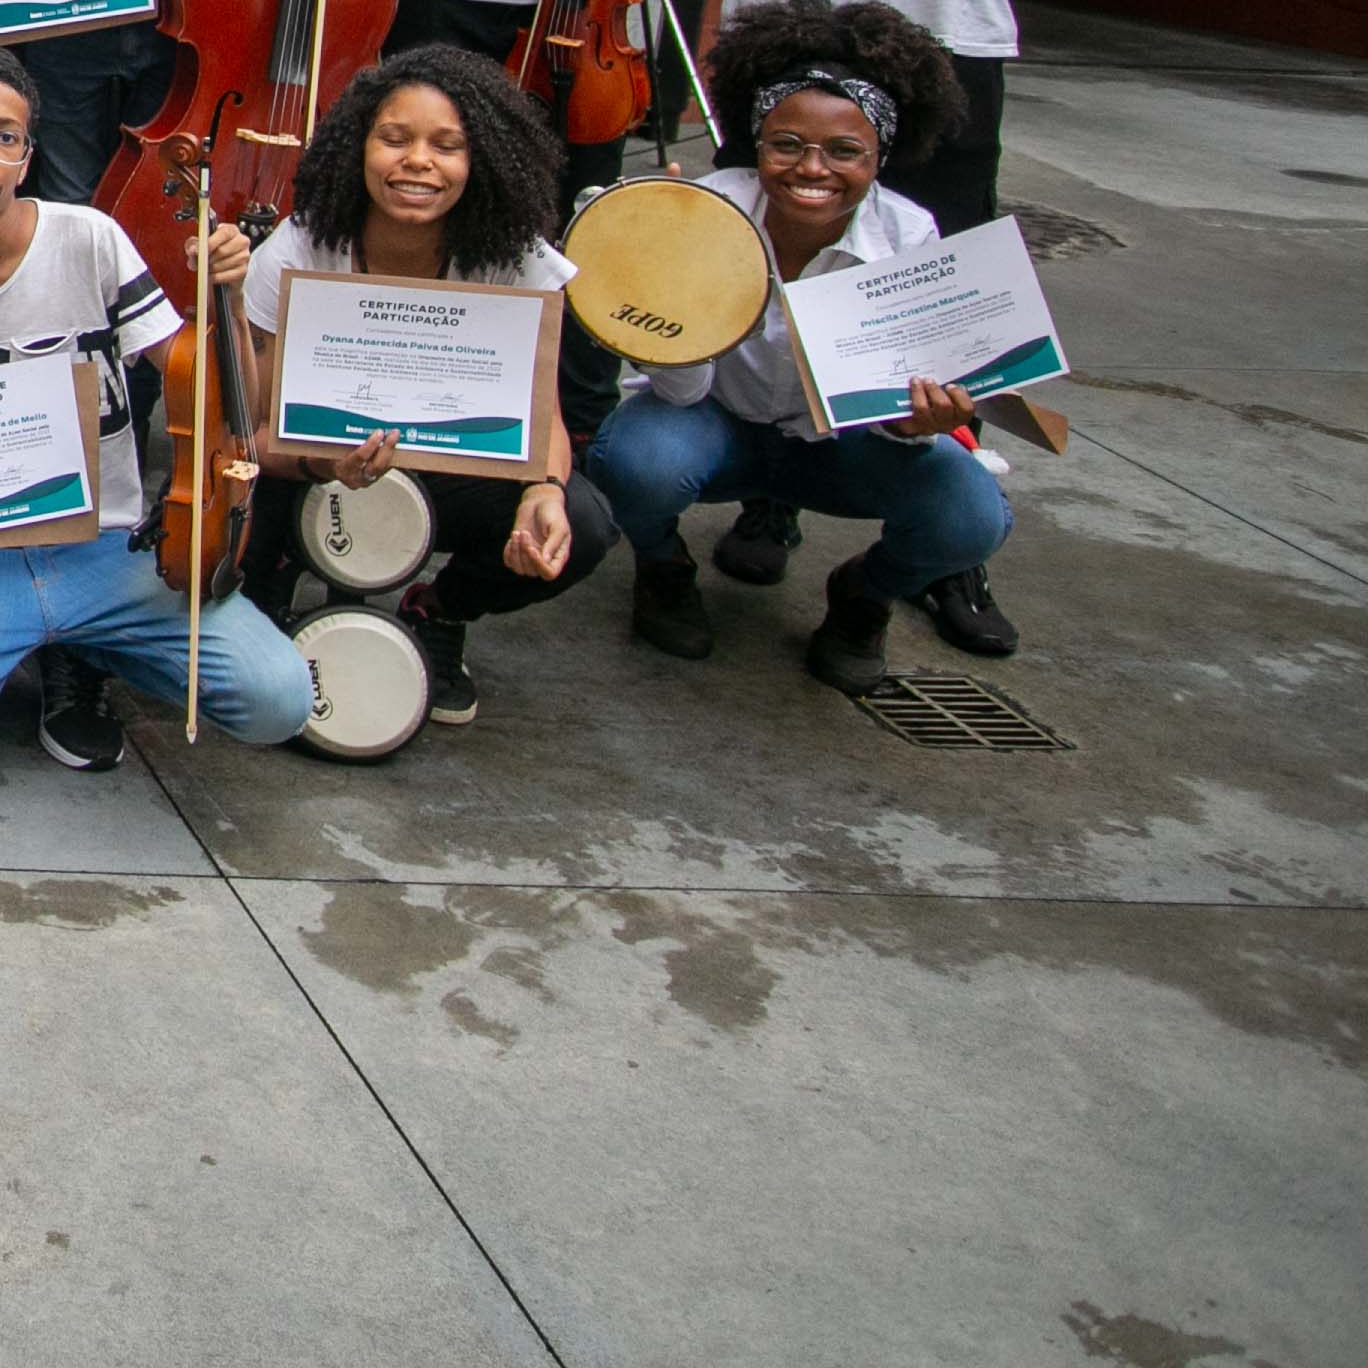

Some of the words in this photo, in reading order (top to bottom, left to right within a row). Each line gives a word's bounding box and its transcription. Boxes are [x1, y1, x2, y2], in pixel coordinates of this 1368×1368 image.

[856, 260, 939, 291] CERTIFICADO
[941, 253, 956, 266] DE
[866, 266, 956, 300] PARTICIPAÇÃO
[359, 299, 446, 315] CERTIFICADO
[450, 306, 466, 316] DE
[363, 311, 459, 327] PARTICIPAÇÃO
[610, 303, 684, 339] GOPE
[860, 312, 899, 328] Priscila
[900, 301, 939, 318] Cristina
[938, 287, 980, 307] Marques
[322, 334, 354, 344] Dyana
[356, 337, 408, 348] Aparecida
[410, 342, 439, 351] Paiva
[456, 345, 496, 356] Oliveira
[8, 418, 19, 426] de
[329, 494, 342, 536] LUEN
